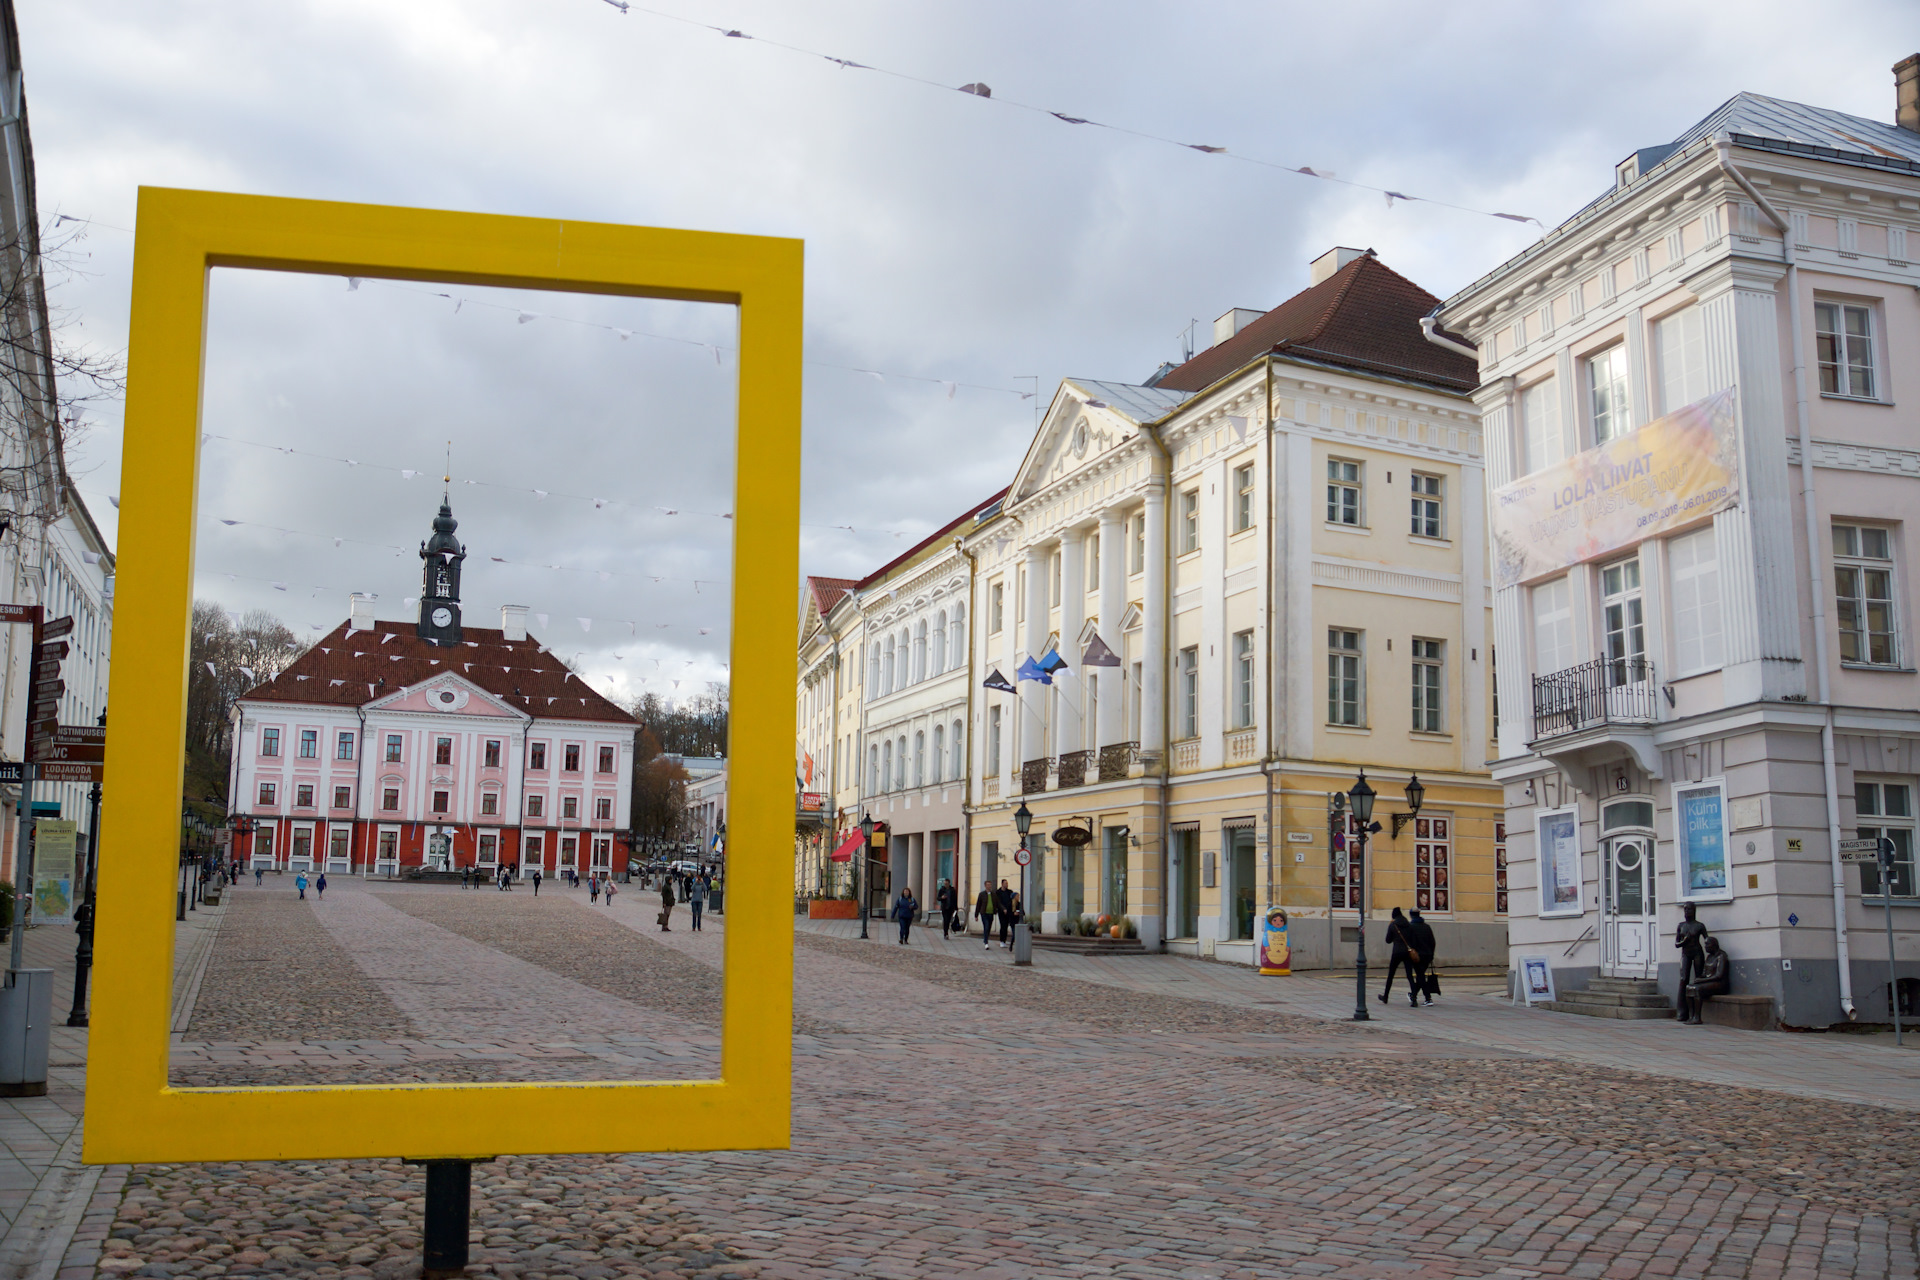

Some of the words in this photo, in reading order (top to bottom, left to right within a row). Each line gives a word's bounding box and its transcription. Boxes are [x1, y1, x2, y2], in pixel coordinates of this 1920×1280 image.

[1554, 478, 1596, 510] LOLA
[1600, 452, 1653, 491] LIIVAT
[1529, 506, 1580, 543] VAIMU
[1583, 463, 1688, 521] VASTUPANU
[45, 765, 92, 774] LODJAKODA
[1617, 778, 1627, 790] 18
[1687, 800, 1718, 817] Külm
[1689, 816, 1710, 834] pilk
[1788, 840, 1801, 848] WC
[1840, 841, 1869, 849] MAGISTRI
